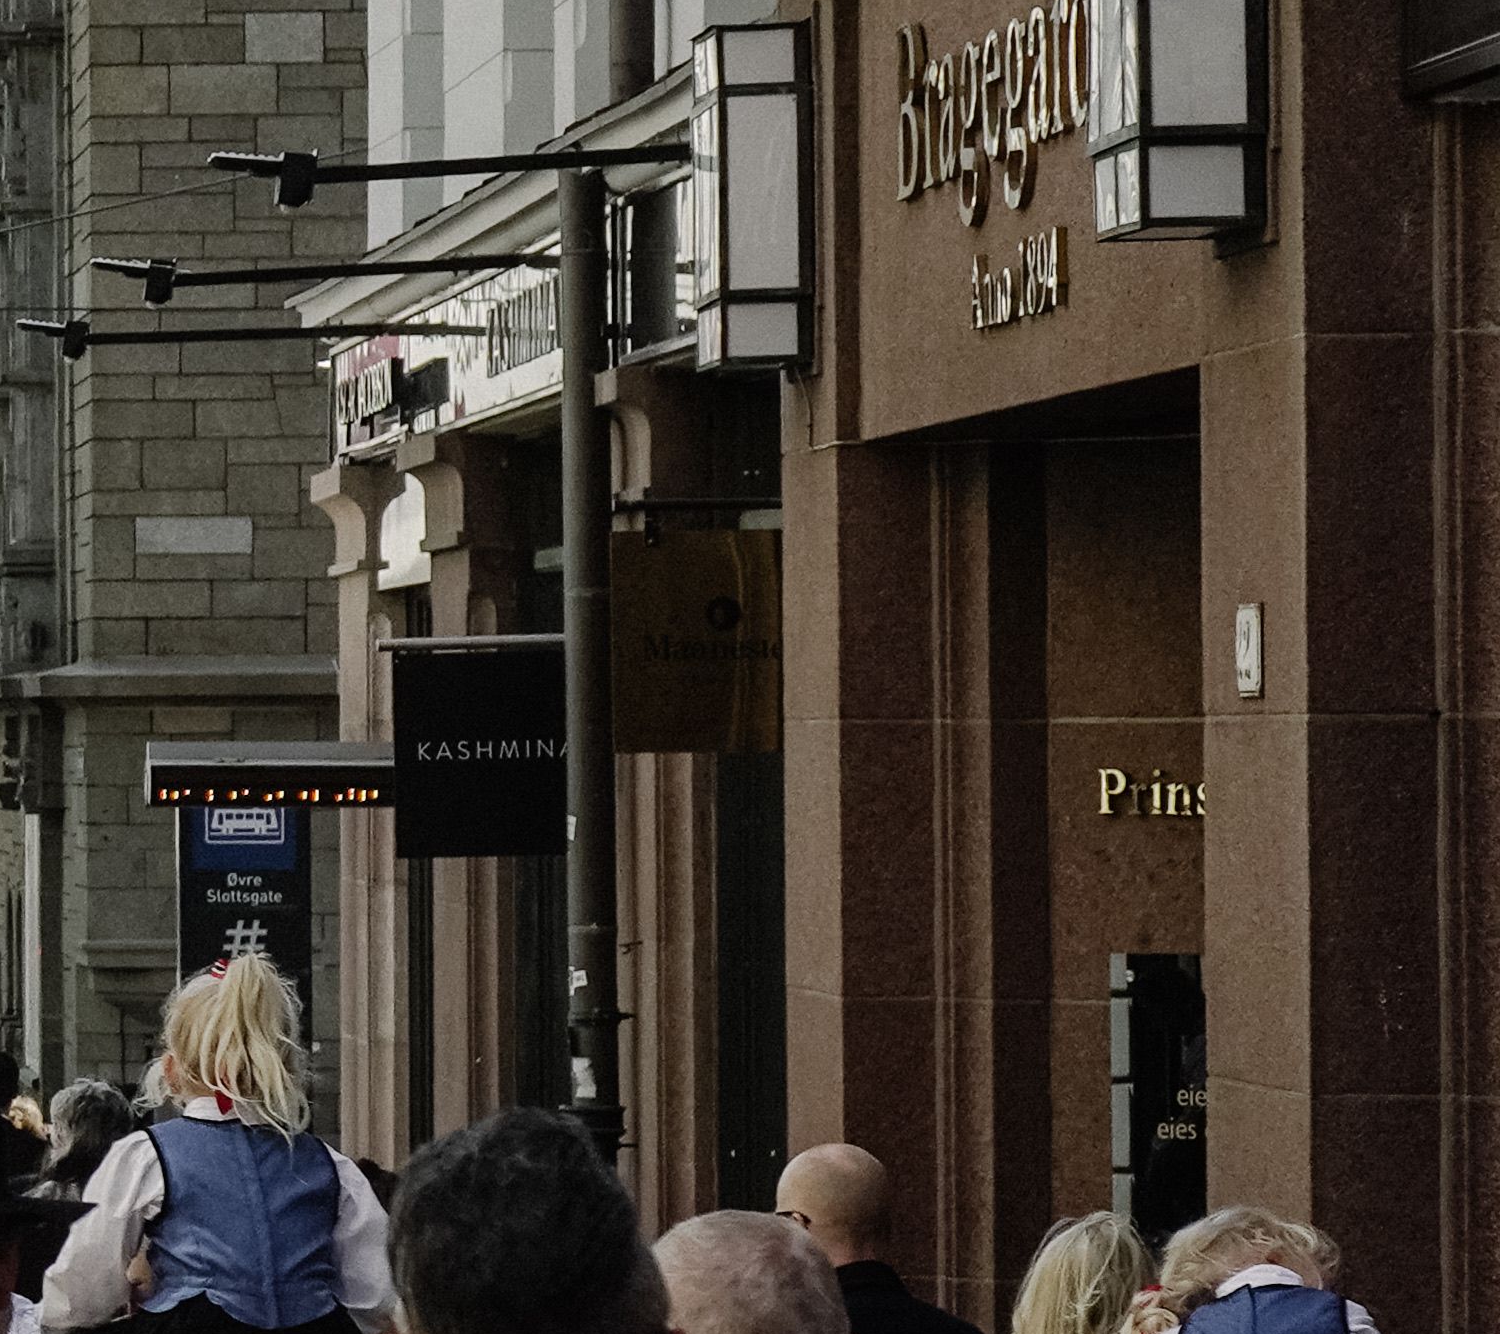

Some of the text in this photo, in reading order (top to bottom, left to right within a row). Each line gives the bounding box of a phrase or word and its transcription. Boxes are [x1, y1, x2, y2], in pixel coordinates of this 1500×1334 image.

[1018, 226, 1059, 317] 1894
[227, 872, 262, 887] Øvre
[207, 888, 283, 907] Slottsgate
[1157, 1119, 1197, 1140] eies
